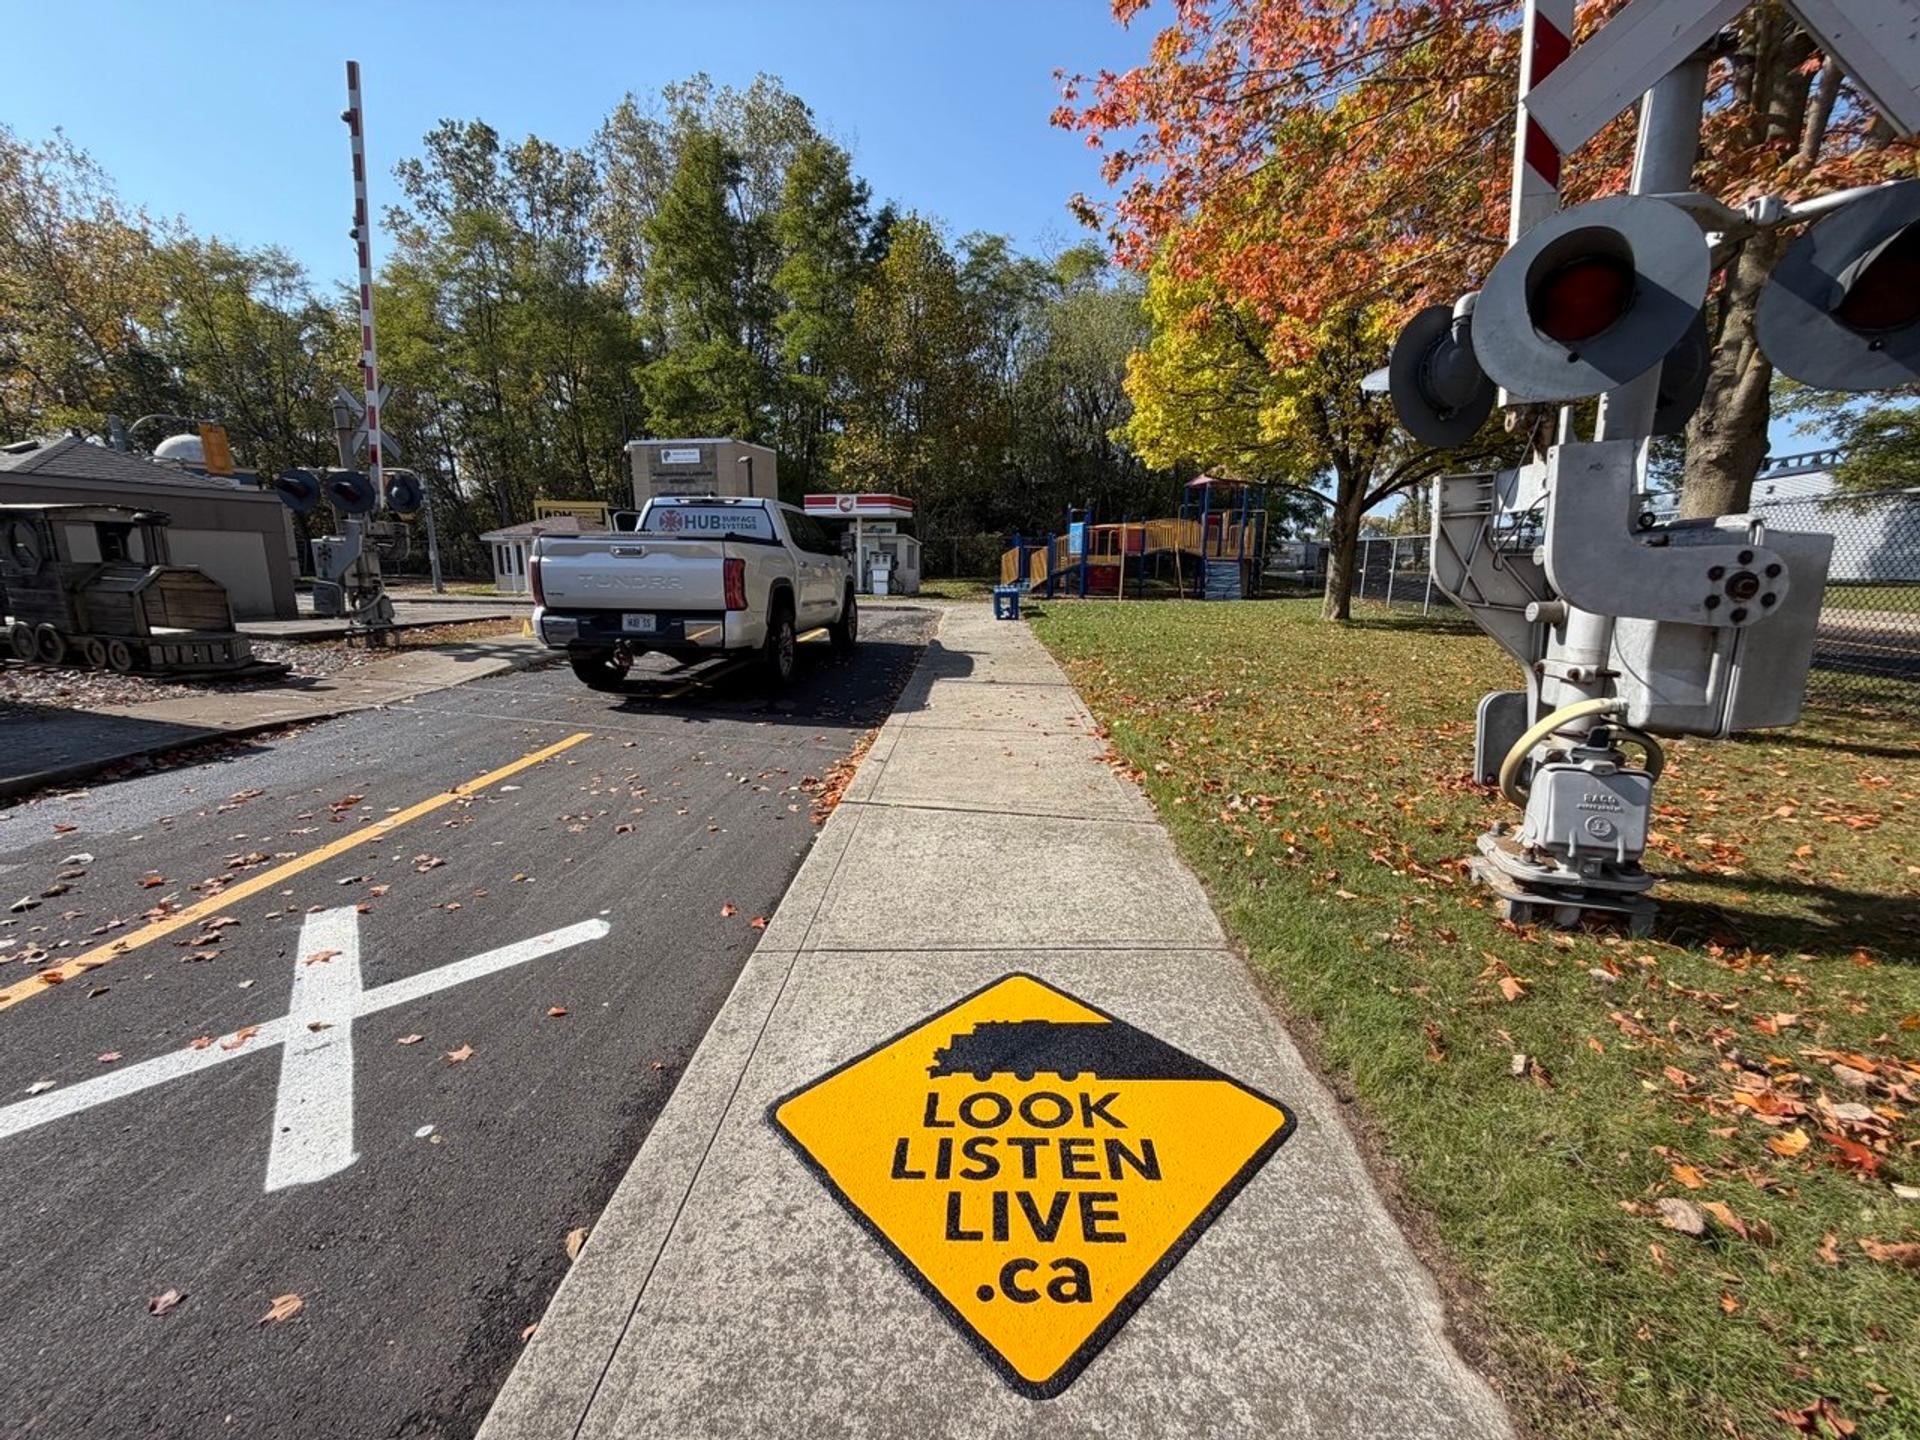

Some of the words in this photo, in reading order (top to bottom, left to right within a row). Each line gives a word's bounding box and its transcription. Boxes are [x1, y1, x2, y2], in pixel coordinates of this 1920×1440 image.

[684, 515, 720, 530] HUB
[577, 573, 684, 590] TUNDRA
[923, 1091, 1129, 1129] LOOK
[890, 1137, 1162, 1181] LISTEN
[945, 1191, 1126, 1244] LIVE
[976, 1257, 1094, 1304] .ca
